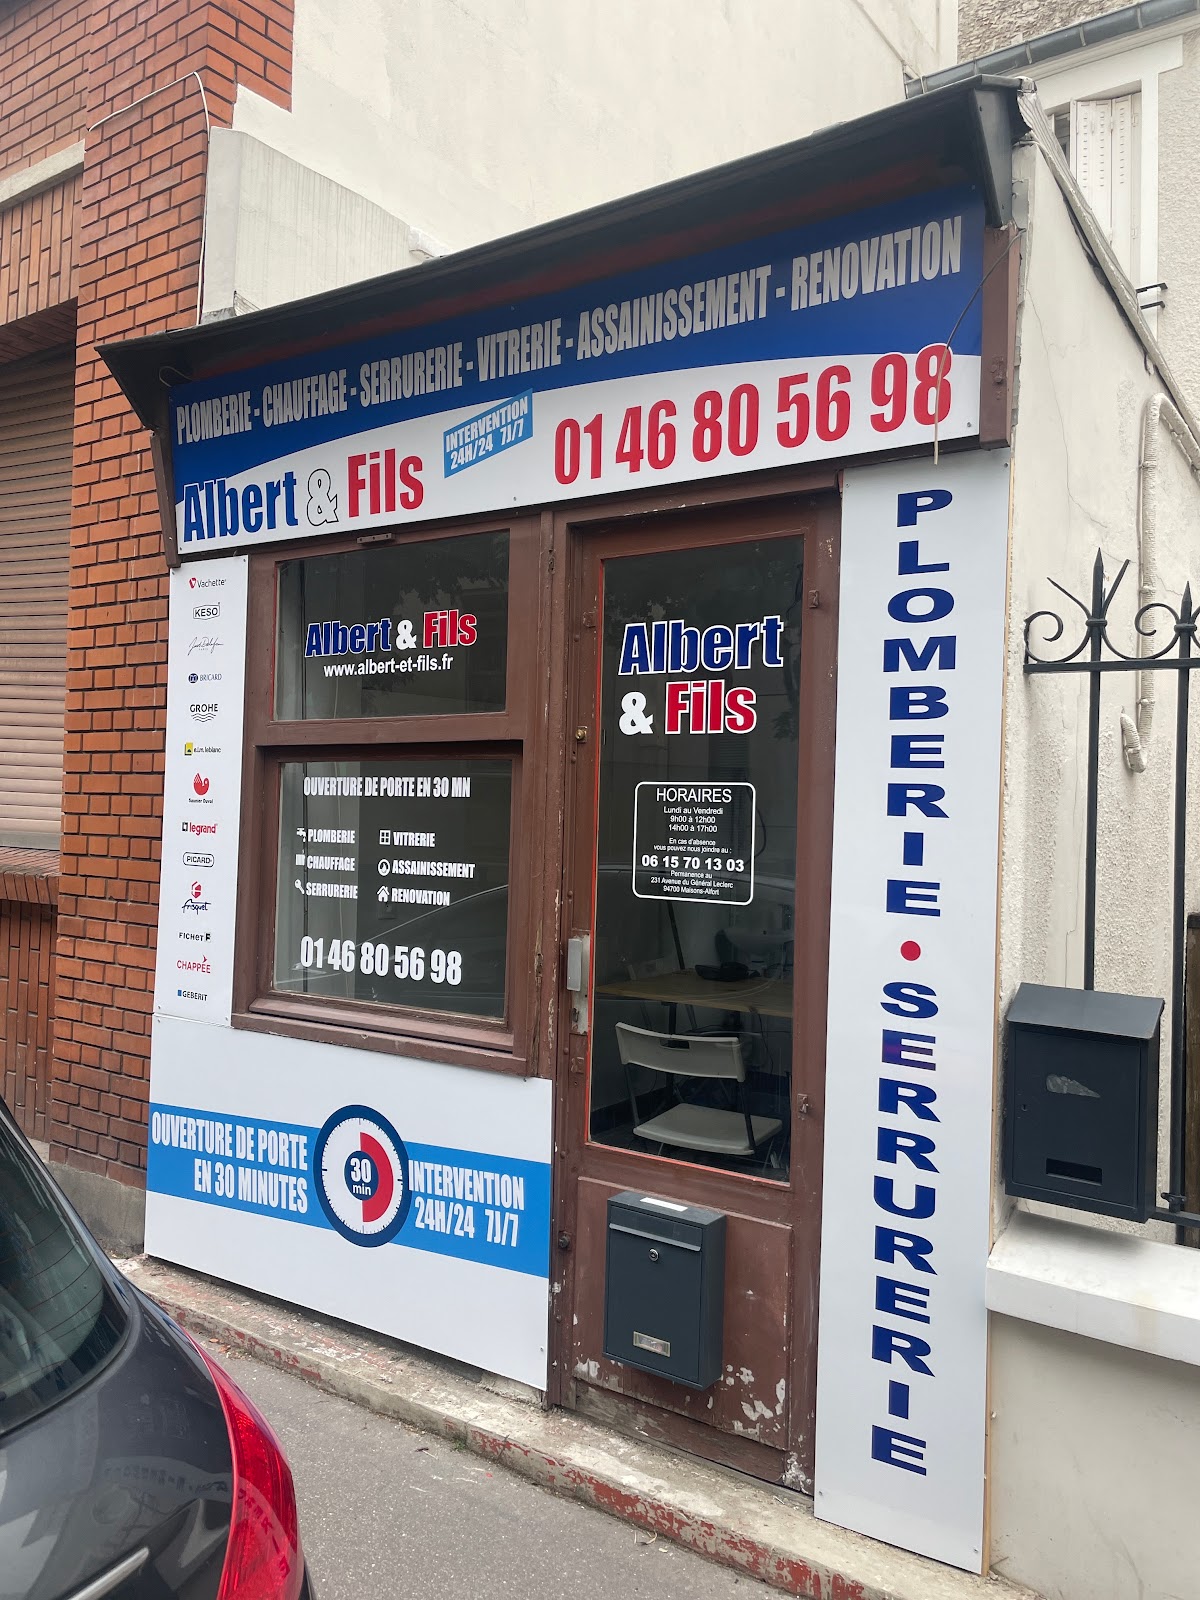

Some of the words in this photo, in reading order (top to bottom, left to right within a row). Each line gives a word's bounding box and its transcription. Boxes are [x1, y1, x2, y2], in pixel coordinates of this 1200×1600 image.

[177, 390, 252, 445] PLOMBERIE
[262, 369, 347, 428] CHAUFFAGE
[360, 342, 462, 408] SERRURERIE
[477, 318, 561, 382] VITRERIE
[576, 265, 771, 361] ASSAINISSEMENT
[791, 215, 961, 311] RENOVATION
[554, 413, 603, 485] 01
[615, 399, 677, 473] 46
[692, 383, 759, 462] 80
[776, 364, 851, 448] 56
[870, 343, 953, 433] 98
[445, 395, 528, 453] INTERVENTION
[450, 438, 493, 470] 24H/24
[499, 418, 524, 446] 7J/7
[183, 471, 299, 542] Albert
[307, 468, 339, 527] &
[347, 448, 424, 518] Fils
[197, 579, 225, 588] Vachette
[195, 607, 218, 617] KESO
[305, 618, 392, 657] Albert
[396, 619, 416, 650] &
[423, 609, 477, 649] Fils
[618, 615, 784, 676] Albert
[324, 653, 453, 677] www.albert-et-fils.fr
[200, 673, 222, 682] BRICARD
[190, 703, 218, 713] GROHE
[618, 691, 653, 736] &
[665, 679, 757, 735] Fils
[882, 489, 957, 917] PLOMBERIE
[303, 777, 362, 797] OUVERTURE
[365, 777, 378, 797] DE
[380, 777, 415, 797] PORTE
[417, 777, 431, 797] EN
[433, 777, 449, 797] 30
[451, 777, 471, 798] MN
[656, 787, 732, 803] HORAIRES
[664, 806, 681, 814] Lundi
[693, 806, 723, 815] Vendredi
[670, 815, 687, 823] 9h00
[695, 815, 716, 824] 12h00
[189, 822, 216, 836] legrand
[307, 828, 355, 844] PLOMBERIE
[668, 824, 689, 832] 14h00
[697, 825, 717, 833] 17h00
[393, 831, 435, 847] VITRERIE
[688, 838, 716, 846] d'absence
[186, 856, 211, 864] PICARD
[307, 855, 355, 872] CHAUFFAGE
[392, 859, 475, 878] ASSAINISSEMENT
[642, 854, 658, 867] 06
[663, 855, 679, 868] 15
[683, 856, 700, 869] 70
[705, 858, 722, 871] 13
[726, 858, 744, 872] 03
[661, 877, 681, 885] Avenue
[690, 879, 712, 887] Général
[670, 870, 704, 878] Permanence
[306, 882, 358, 899] SERRURERIE
[391, 888, 450, 906] RENOVATION
[681, 886, 720, 895] Maisons-Alfort
[182, 898, 211, 915] frisquet
[300, 936, 323, 968] 01
[327, 939, 356, 972] 46
[360, 942, 389, 976] 80
[394, 945, 425, 981] 56
[430, 949, 462, 986] 98
[182, 991, 207, 1001] GEBERIT
[152, 1111, 232, 1157] OUVERTURE
[235, 1125, 255, 1161] DE
[258, 1127, 308, 1171] PORTE
[350, 1157, 372, 1183] 30
[194, 1158, 211, 1193] EN
[215, 1162, 234, 1197] 30
[238, 1165, 308, 1214] MINUTES
[352, 1182, 371, 1196] min
[408, 1159, 524, 1211] INTERVENTION
[415, 1197, 474, 1239] 24H/24
[485, 1209, 519, 1248] 7J/7
[871, 981, 942, 1476] SERRURERIE
